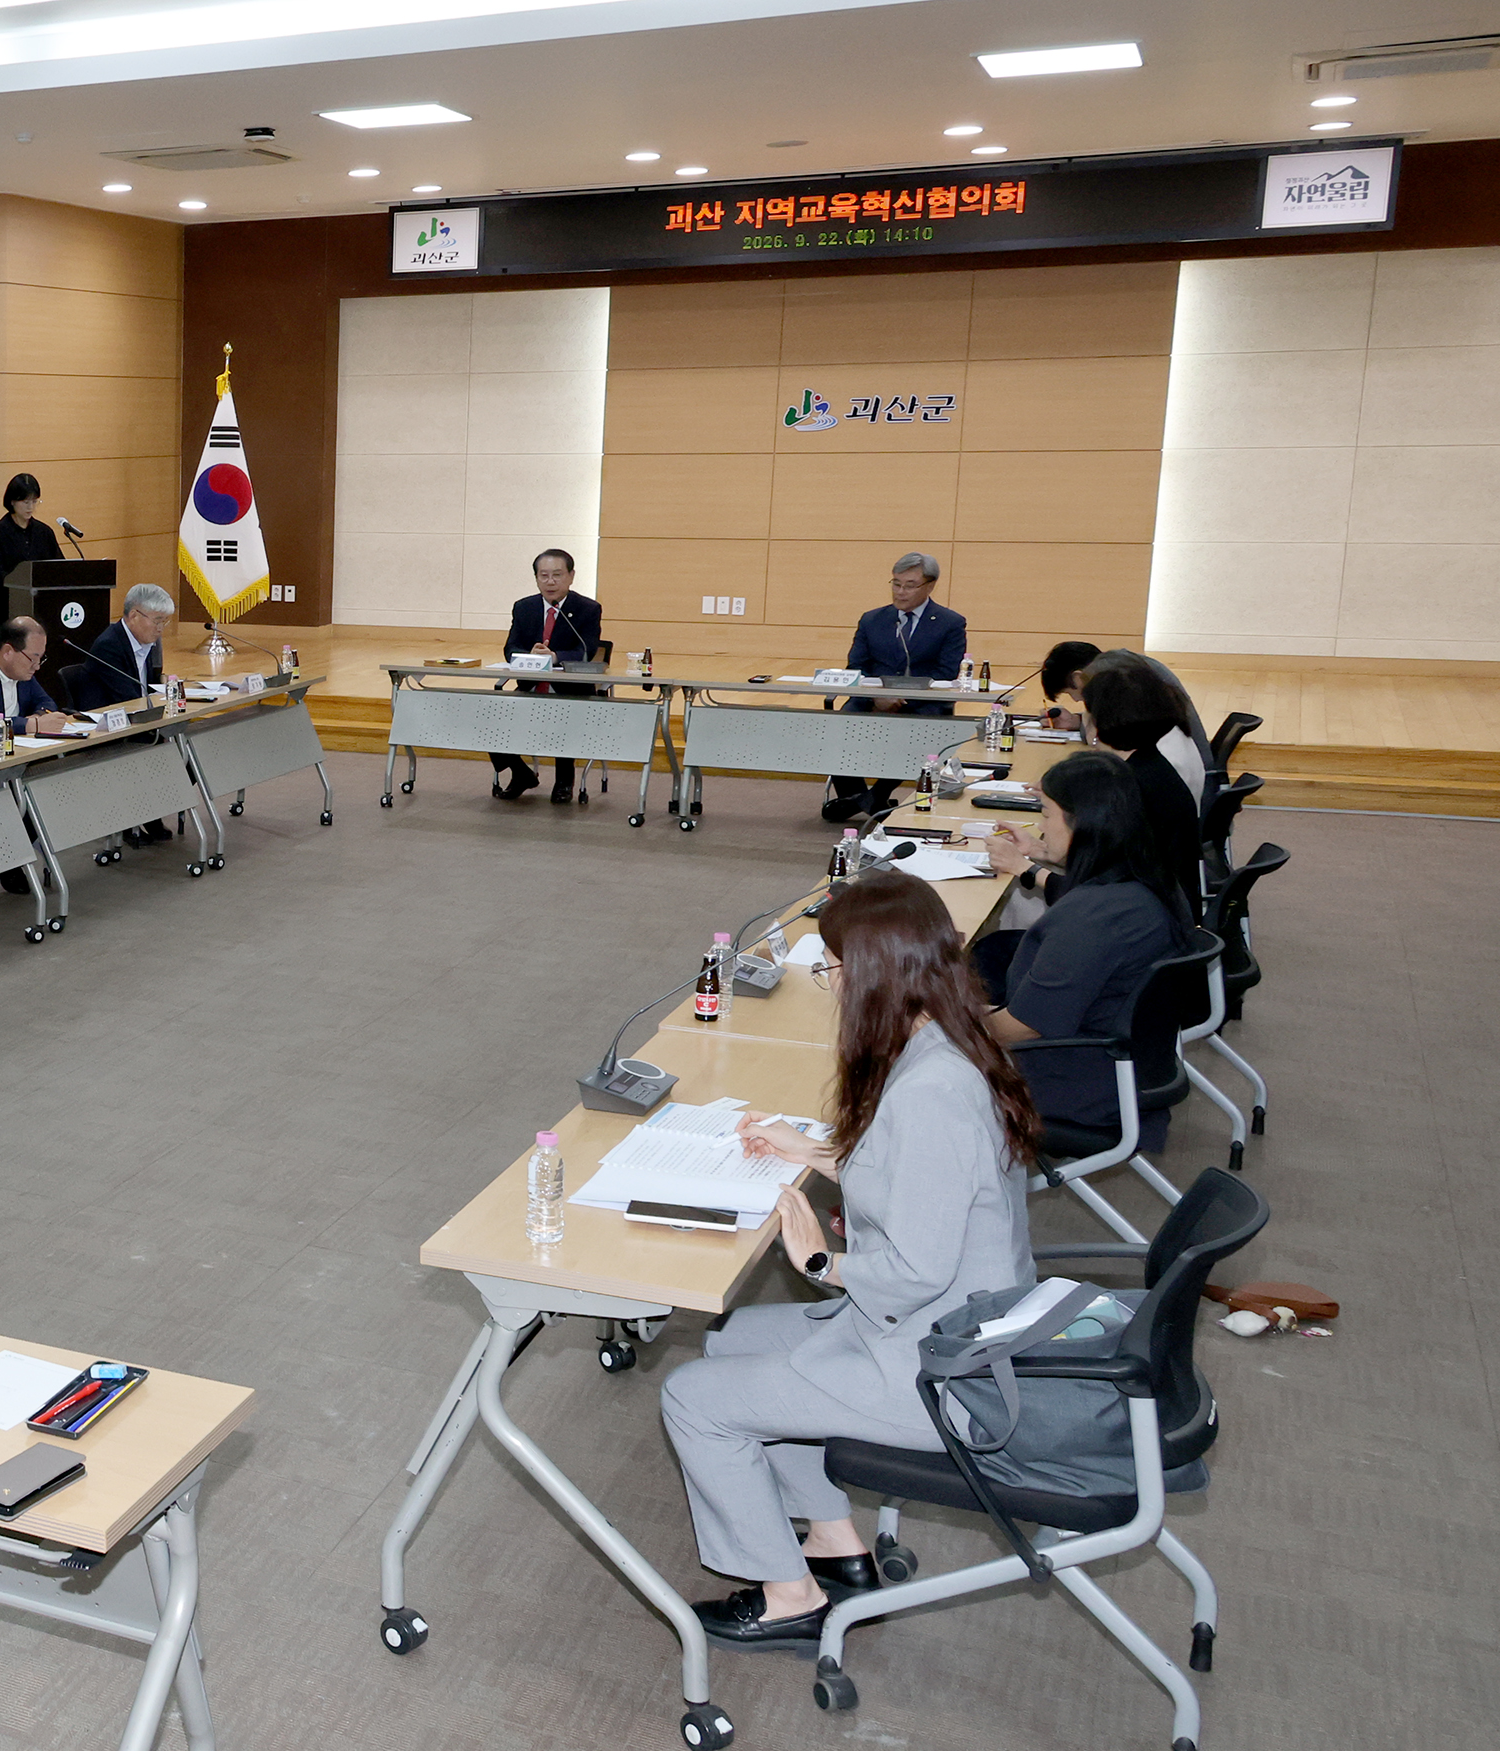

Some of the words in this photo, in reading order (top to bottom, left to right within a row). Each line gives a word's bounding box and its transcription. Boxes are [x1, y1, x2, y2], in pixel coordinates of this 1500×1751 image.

[1283, 180, 1370, 203] 자연울림
[665, 200, 725, 233] 괴산
[734, 181, 1026, 229] 지역교육혁신협의회
[742, 235, 788, 249] 2026.
[795, 233, 810, 248] 9.
[884, 226, 933, 242] 14:10
[410, 251, 460, 265] 괴산군
[844, 394, 957, 424] 괴산군
